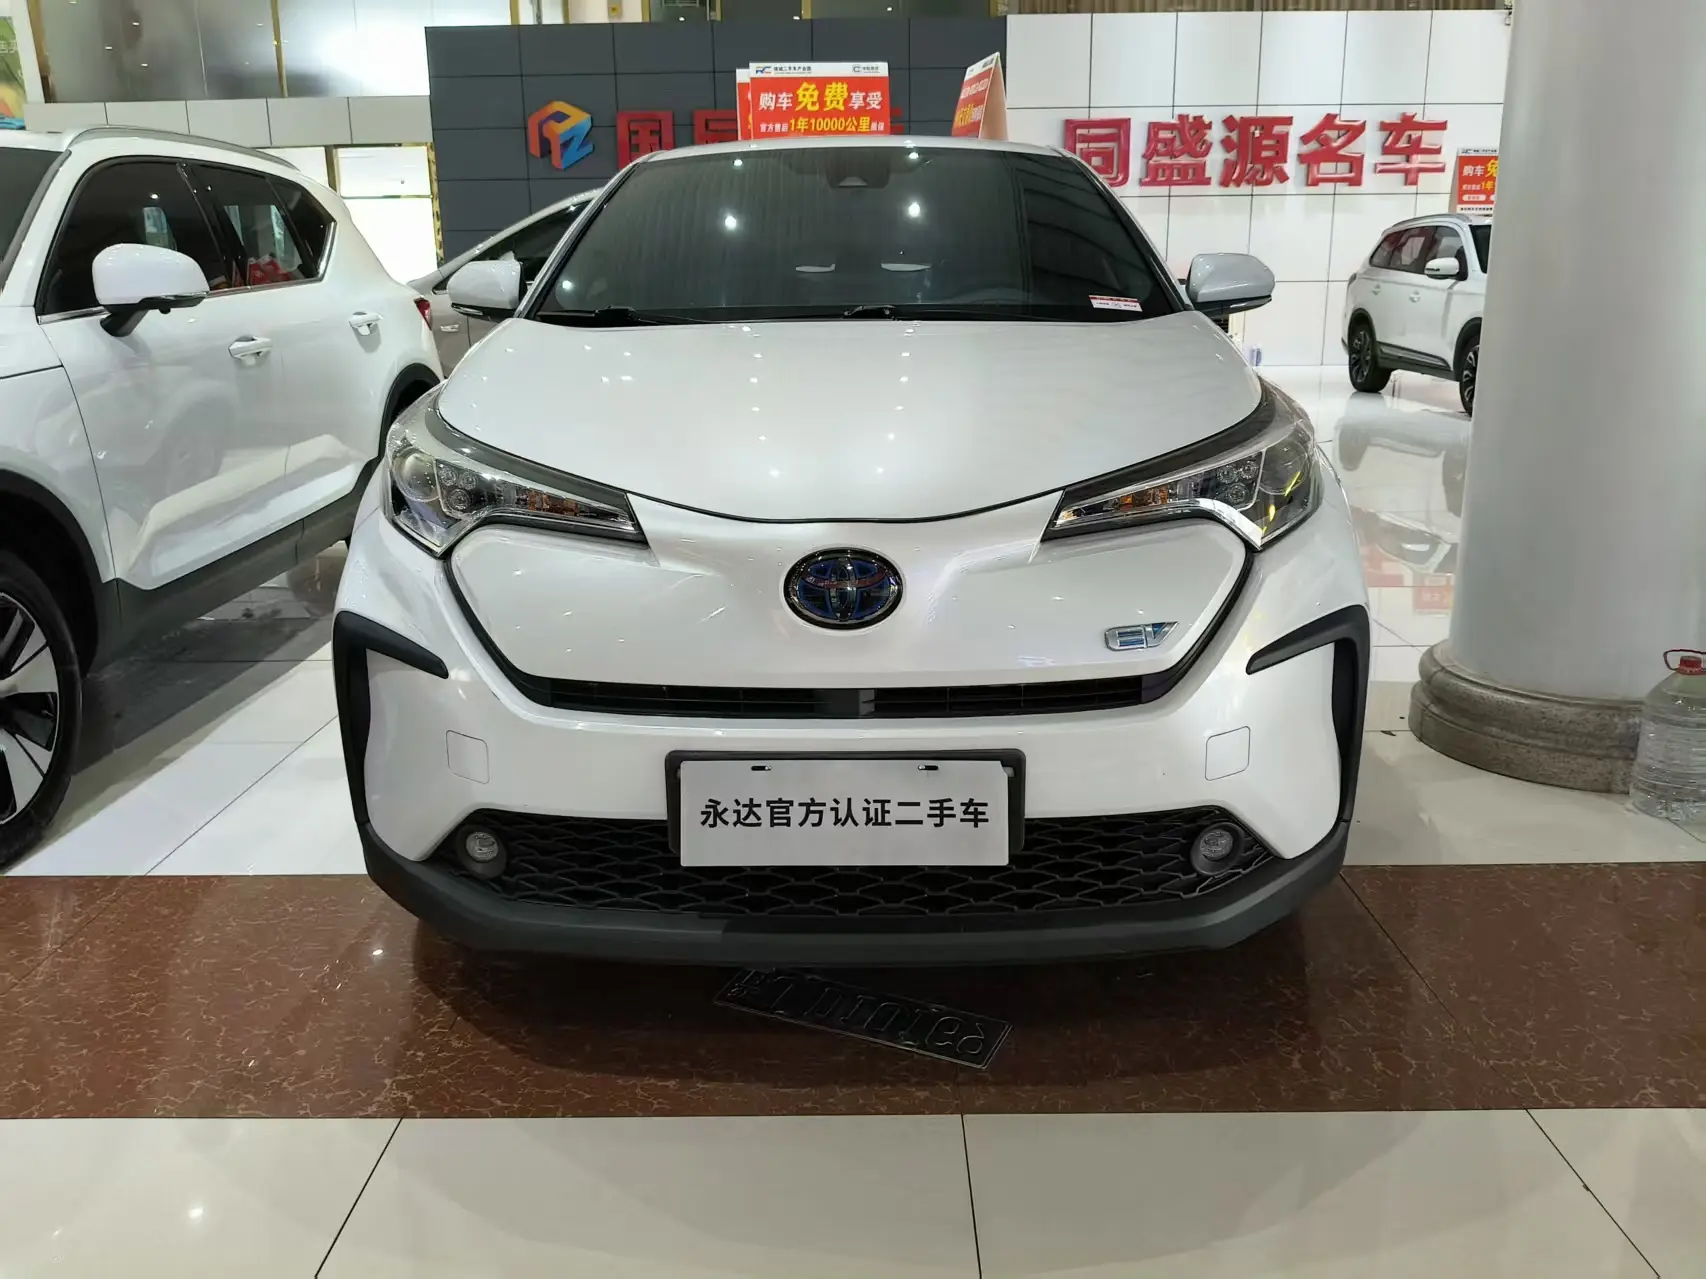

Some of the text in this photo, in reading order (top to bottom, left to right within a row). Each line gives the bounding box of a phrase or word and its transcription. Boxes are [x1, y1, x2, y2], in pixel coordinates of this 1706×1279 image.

[759, 82, 882, 111] 购车免费享受
[1064, 112, 1448, 188] 同盛源名车
[700, 797, 990, 829] 永达官方认证二手车
